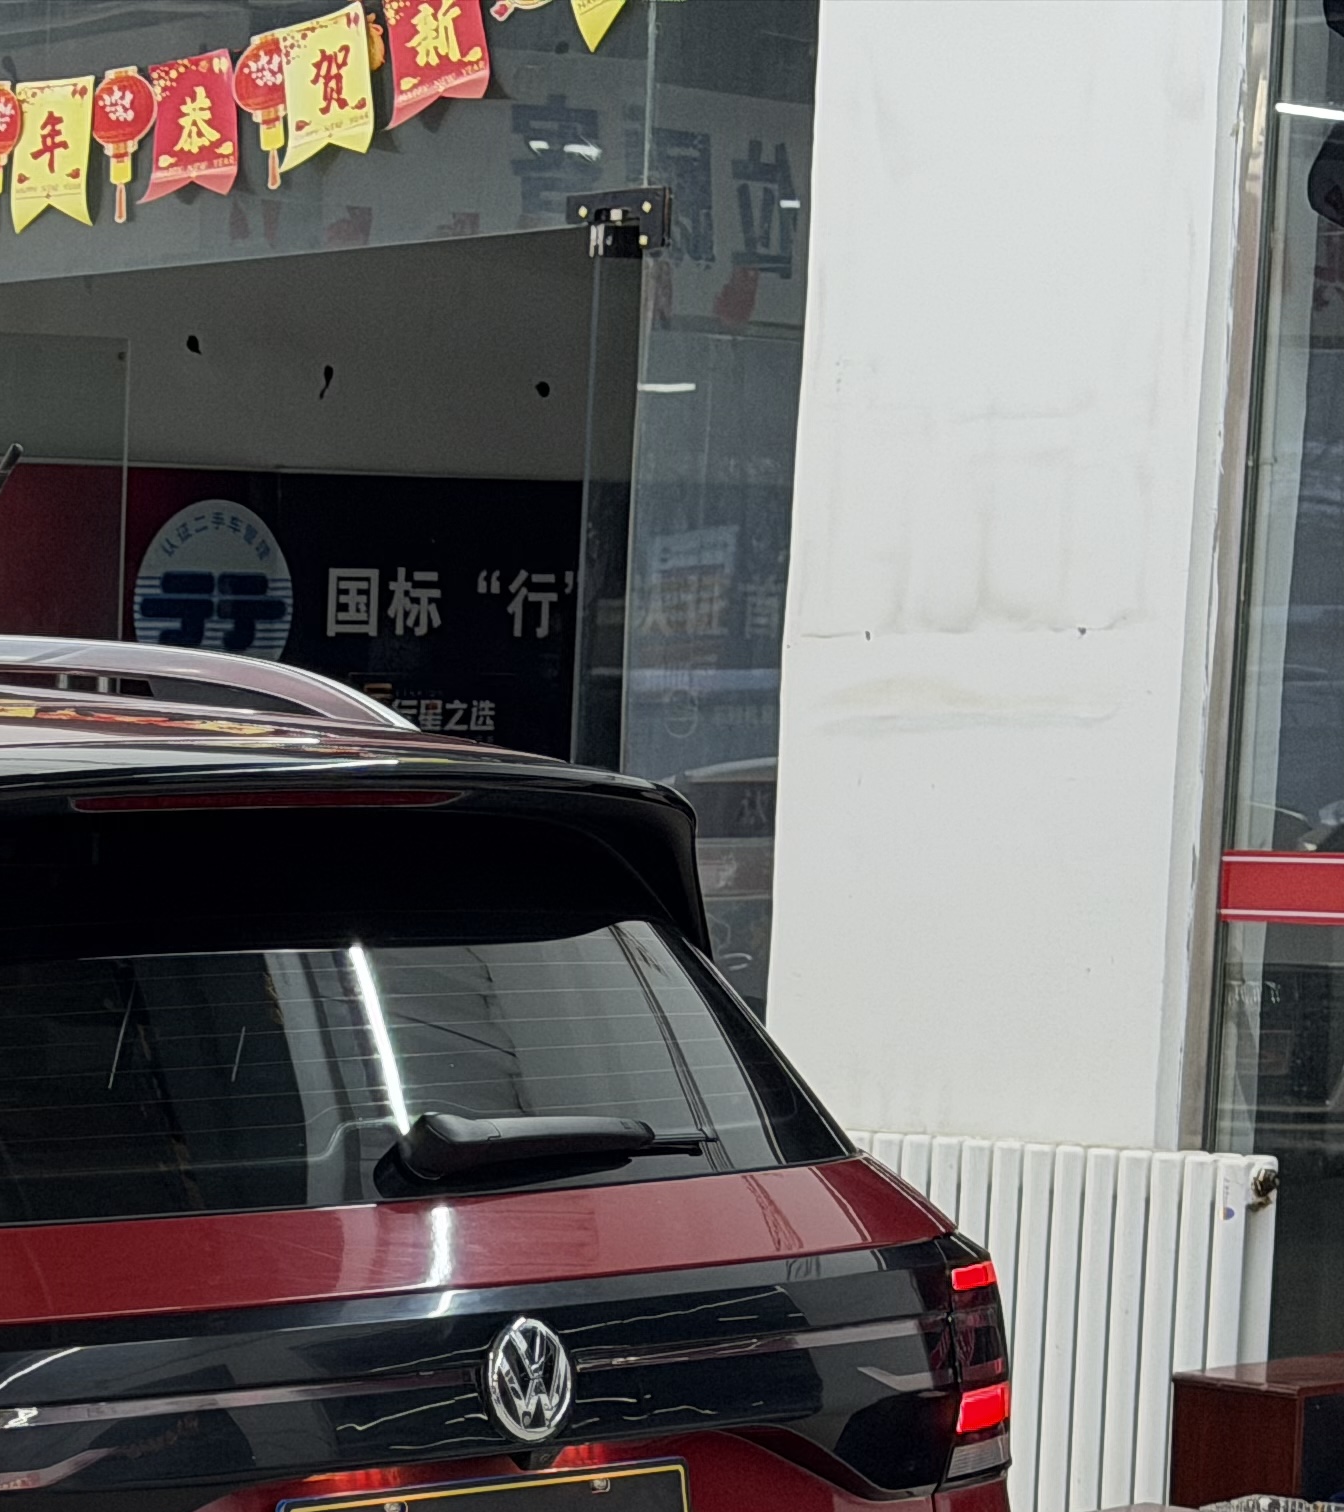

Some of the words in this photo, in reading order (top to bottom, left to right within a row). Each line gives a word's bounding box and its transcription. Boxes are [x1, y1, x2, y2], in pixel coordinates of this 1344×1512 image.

[310, 44, 351, 115] 贺
[30, 111, 69, 174] 年
[173, 86, 221, 154] 恭
